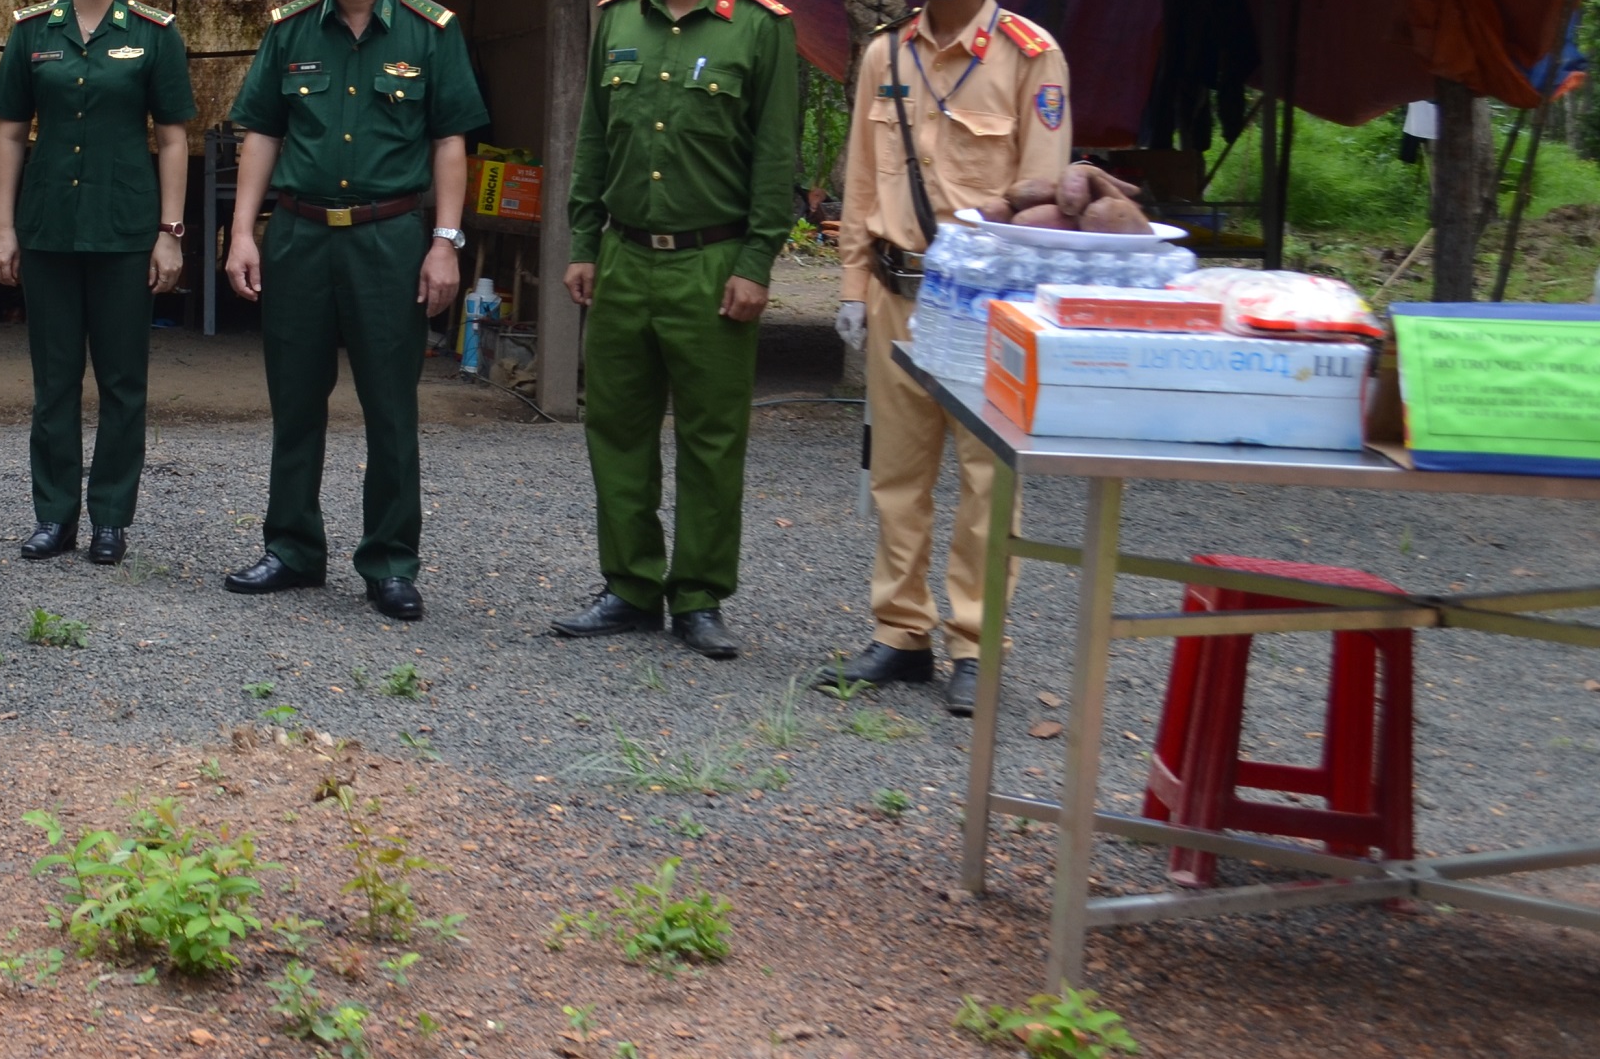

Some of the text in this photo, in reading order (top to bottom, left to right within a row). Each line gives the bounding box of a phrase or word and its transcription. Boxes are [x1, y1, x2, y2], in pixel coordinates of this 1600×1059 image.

[484, 166, 499, 212] BONCHA
[1230, 351, 1291, 378] true
[1314, 355, 1353, 378] TH
